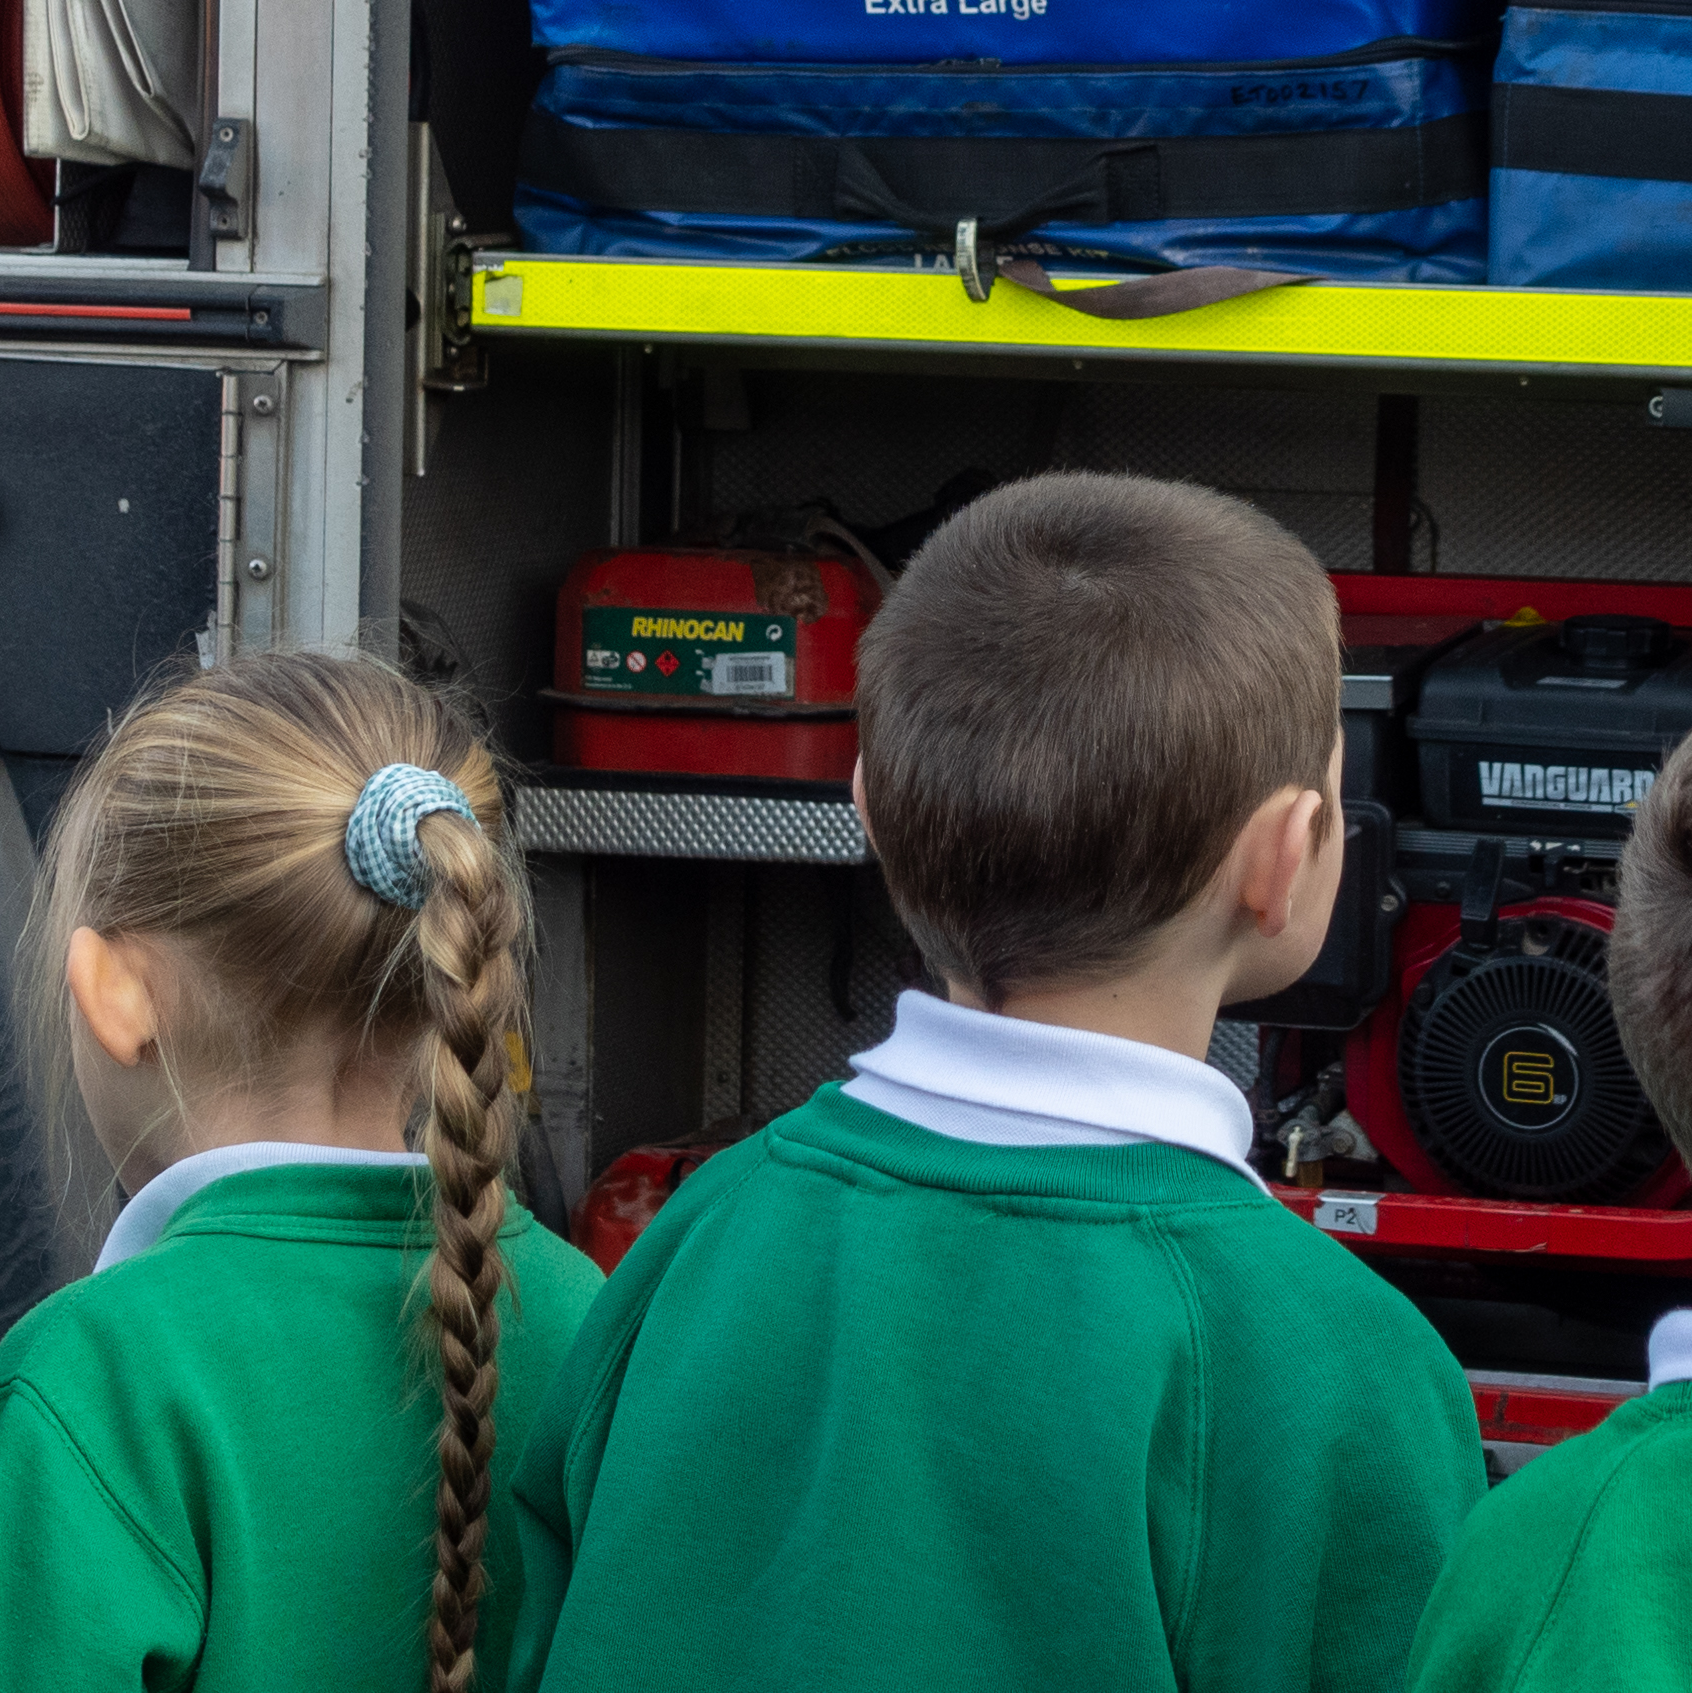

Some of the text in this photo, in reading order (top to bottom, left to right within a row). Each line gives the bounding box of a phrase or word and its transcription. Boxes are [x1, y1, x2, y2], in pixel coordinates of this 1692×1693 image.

[631, 615, 745, 643] RHINOCAN
[1478, 760, 1657, 804] VANGUARD
[1503, 1051, 1555, 1105] 6
[1333, 1207, 1357, 1225] P2
